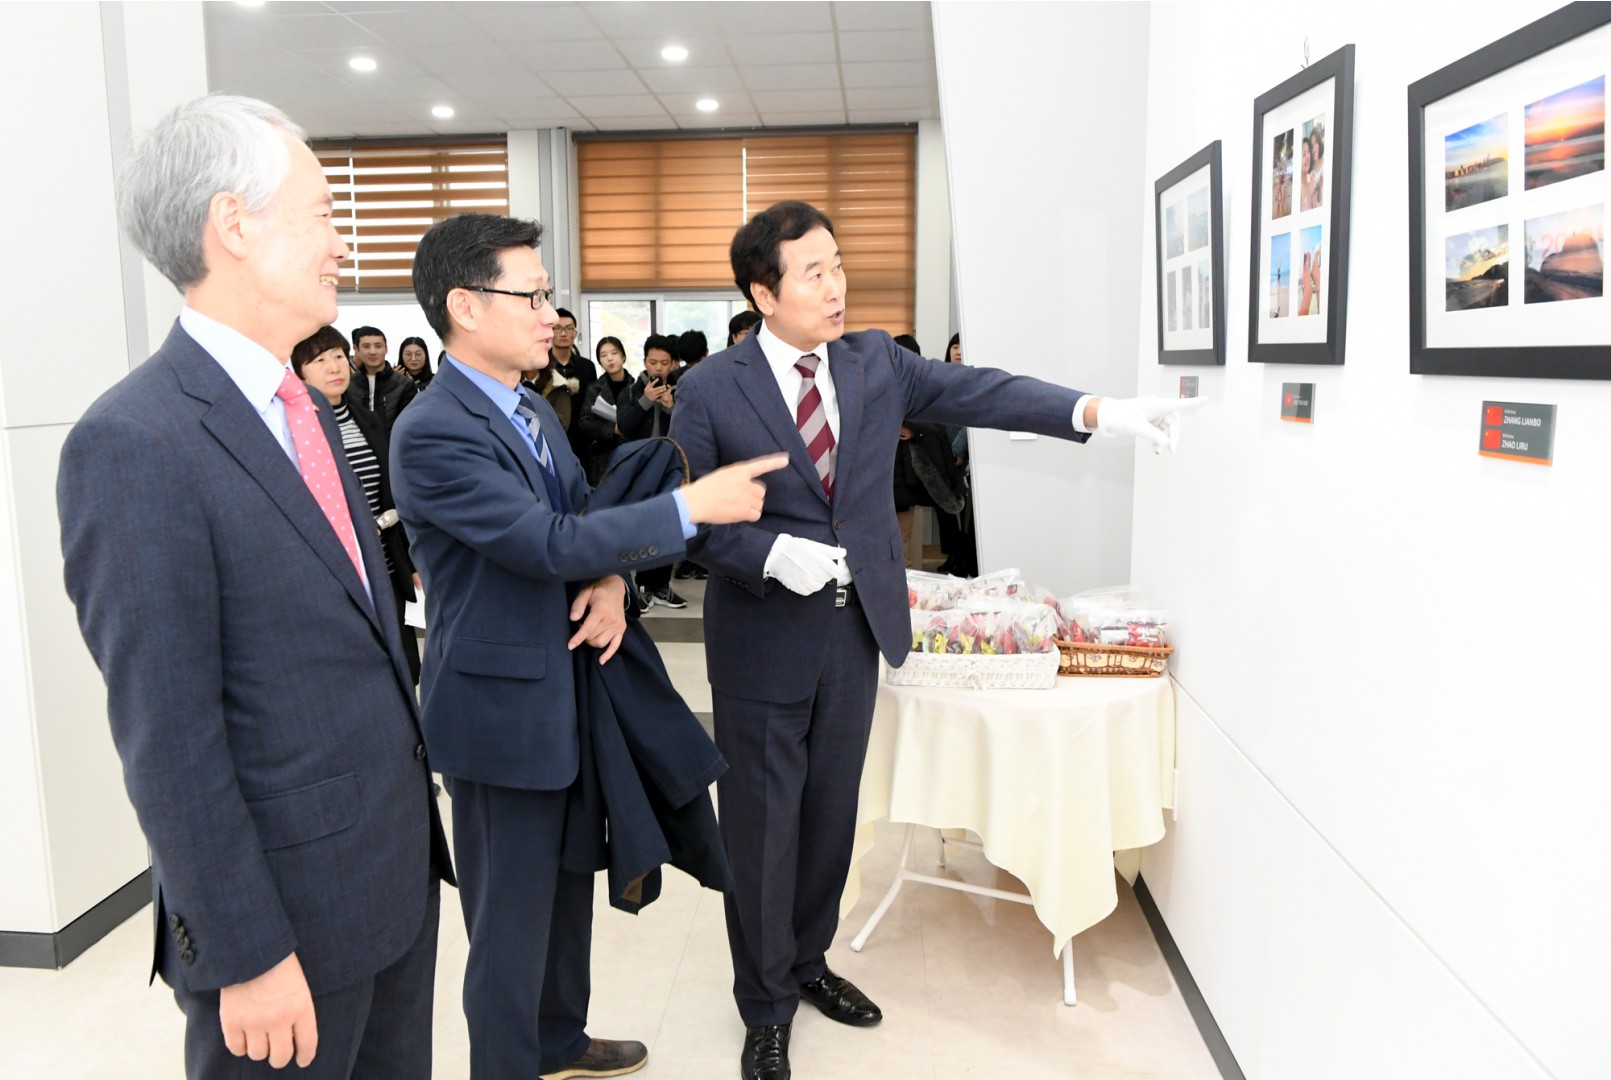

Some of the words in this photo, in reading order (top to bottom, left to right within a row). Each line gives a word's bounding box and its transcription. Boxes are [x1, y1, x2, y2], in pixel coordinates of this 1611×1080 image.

[1503, 416, 1521, 425] ZHANG
[1521, 417, 1542, 427] LIANBO
[1501, 440, 1516, 449] ZHAO
[1516, 441, 1529, 451] LIRU
